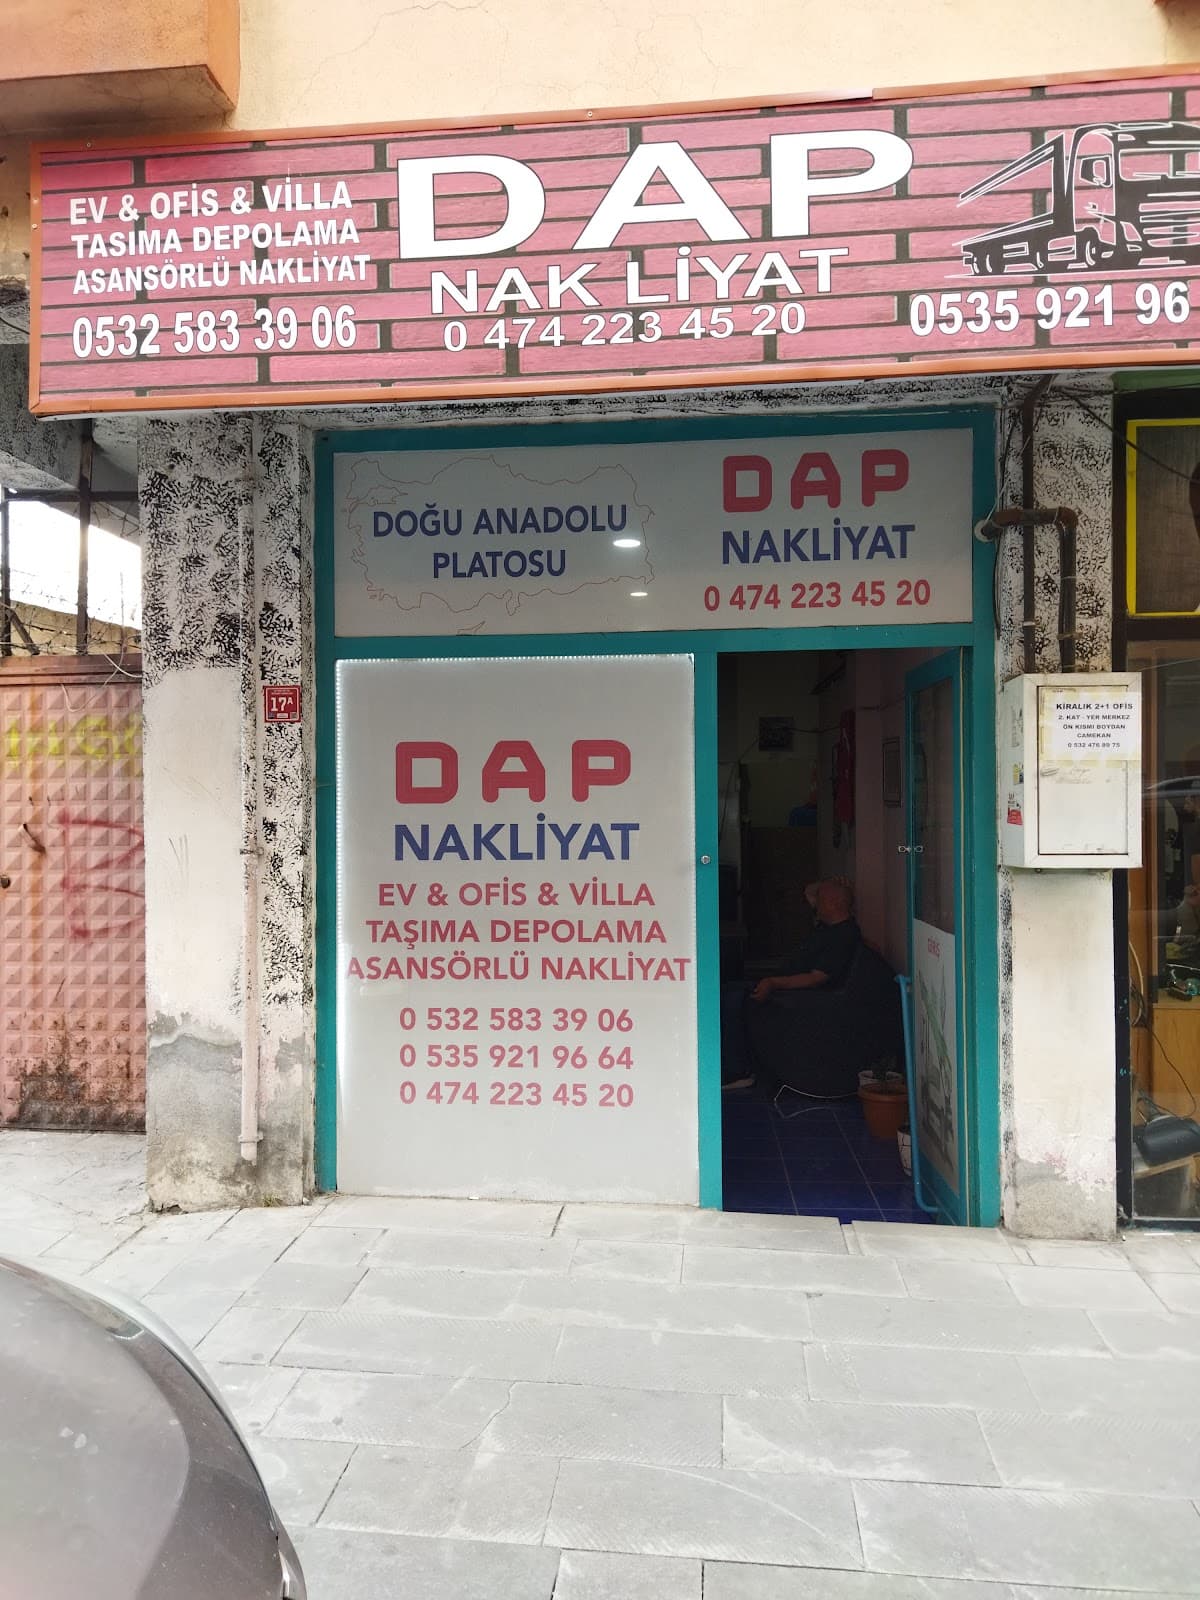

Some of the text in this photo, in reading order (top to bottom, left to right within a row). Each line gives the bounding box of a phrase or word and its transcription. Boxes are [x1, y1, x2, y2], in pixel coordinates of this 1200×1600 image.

[70, 176, 353, 226] EV & OFİS & VİLLA
[398, 130, 914, 259] DAP
[70, 218, 360, 259] TASIMA DEPOLAMA
[73, 249, 371, 295] ASANSÖRLÜ NAKLİYAT
[444, 302, 806, 352] 0 474 223 45 20
[910, 281, 1190, 336] 0535 921 96
[72, 304, 356, 358] 0532 583 39 06
[722, 449, 909, 513] DAP
[373, 503, 627, 538] DOĞU ANADOLU
[722, 517, 916, 565] NAKLİYAT
[433, 550, 567, 579] PLATOSU
[704, 579, 931, 612] 0 474 223 45 20
[1056, 702, 1092, 710] KİRALIK
[1112, 702, 1133, 710] OFİS
[395, 739, 632, 804] DAP
[394, 812, 640, 861] NAKLİYAT
[378, 876, 656, 906] EV & OFİS & VİLLA
[365, 919, 667, 950] TAŞIMA DEPOLAMA
[346, 950, 691, 981] ASANSÖRLÜ NAKLİYAT
[399, 1008, 634, 1034] 0 532 583 39 06
[399, 1044, 634, 1070] 0 535 921 96 64
[399, 1081, 634, 1107] 0 474 223 45 20
